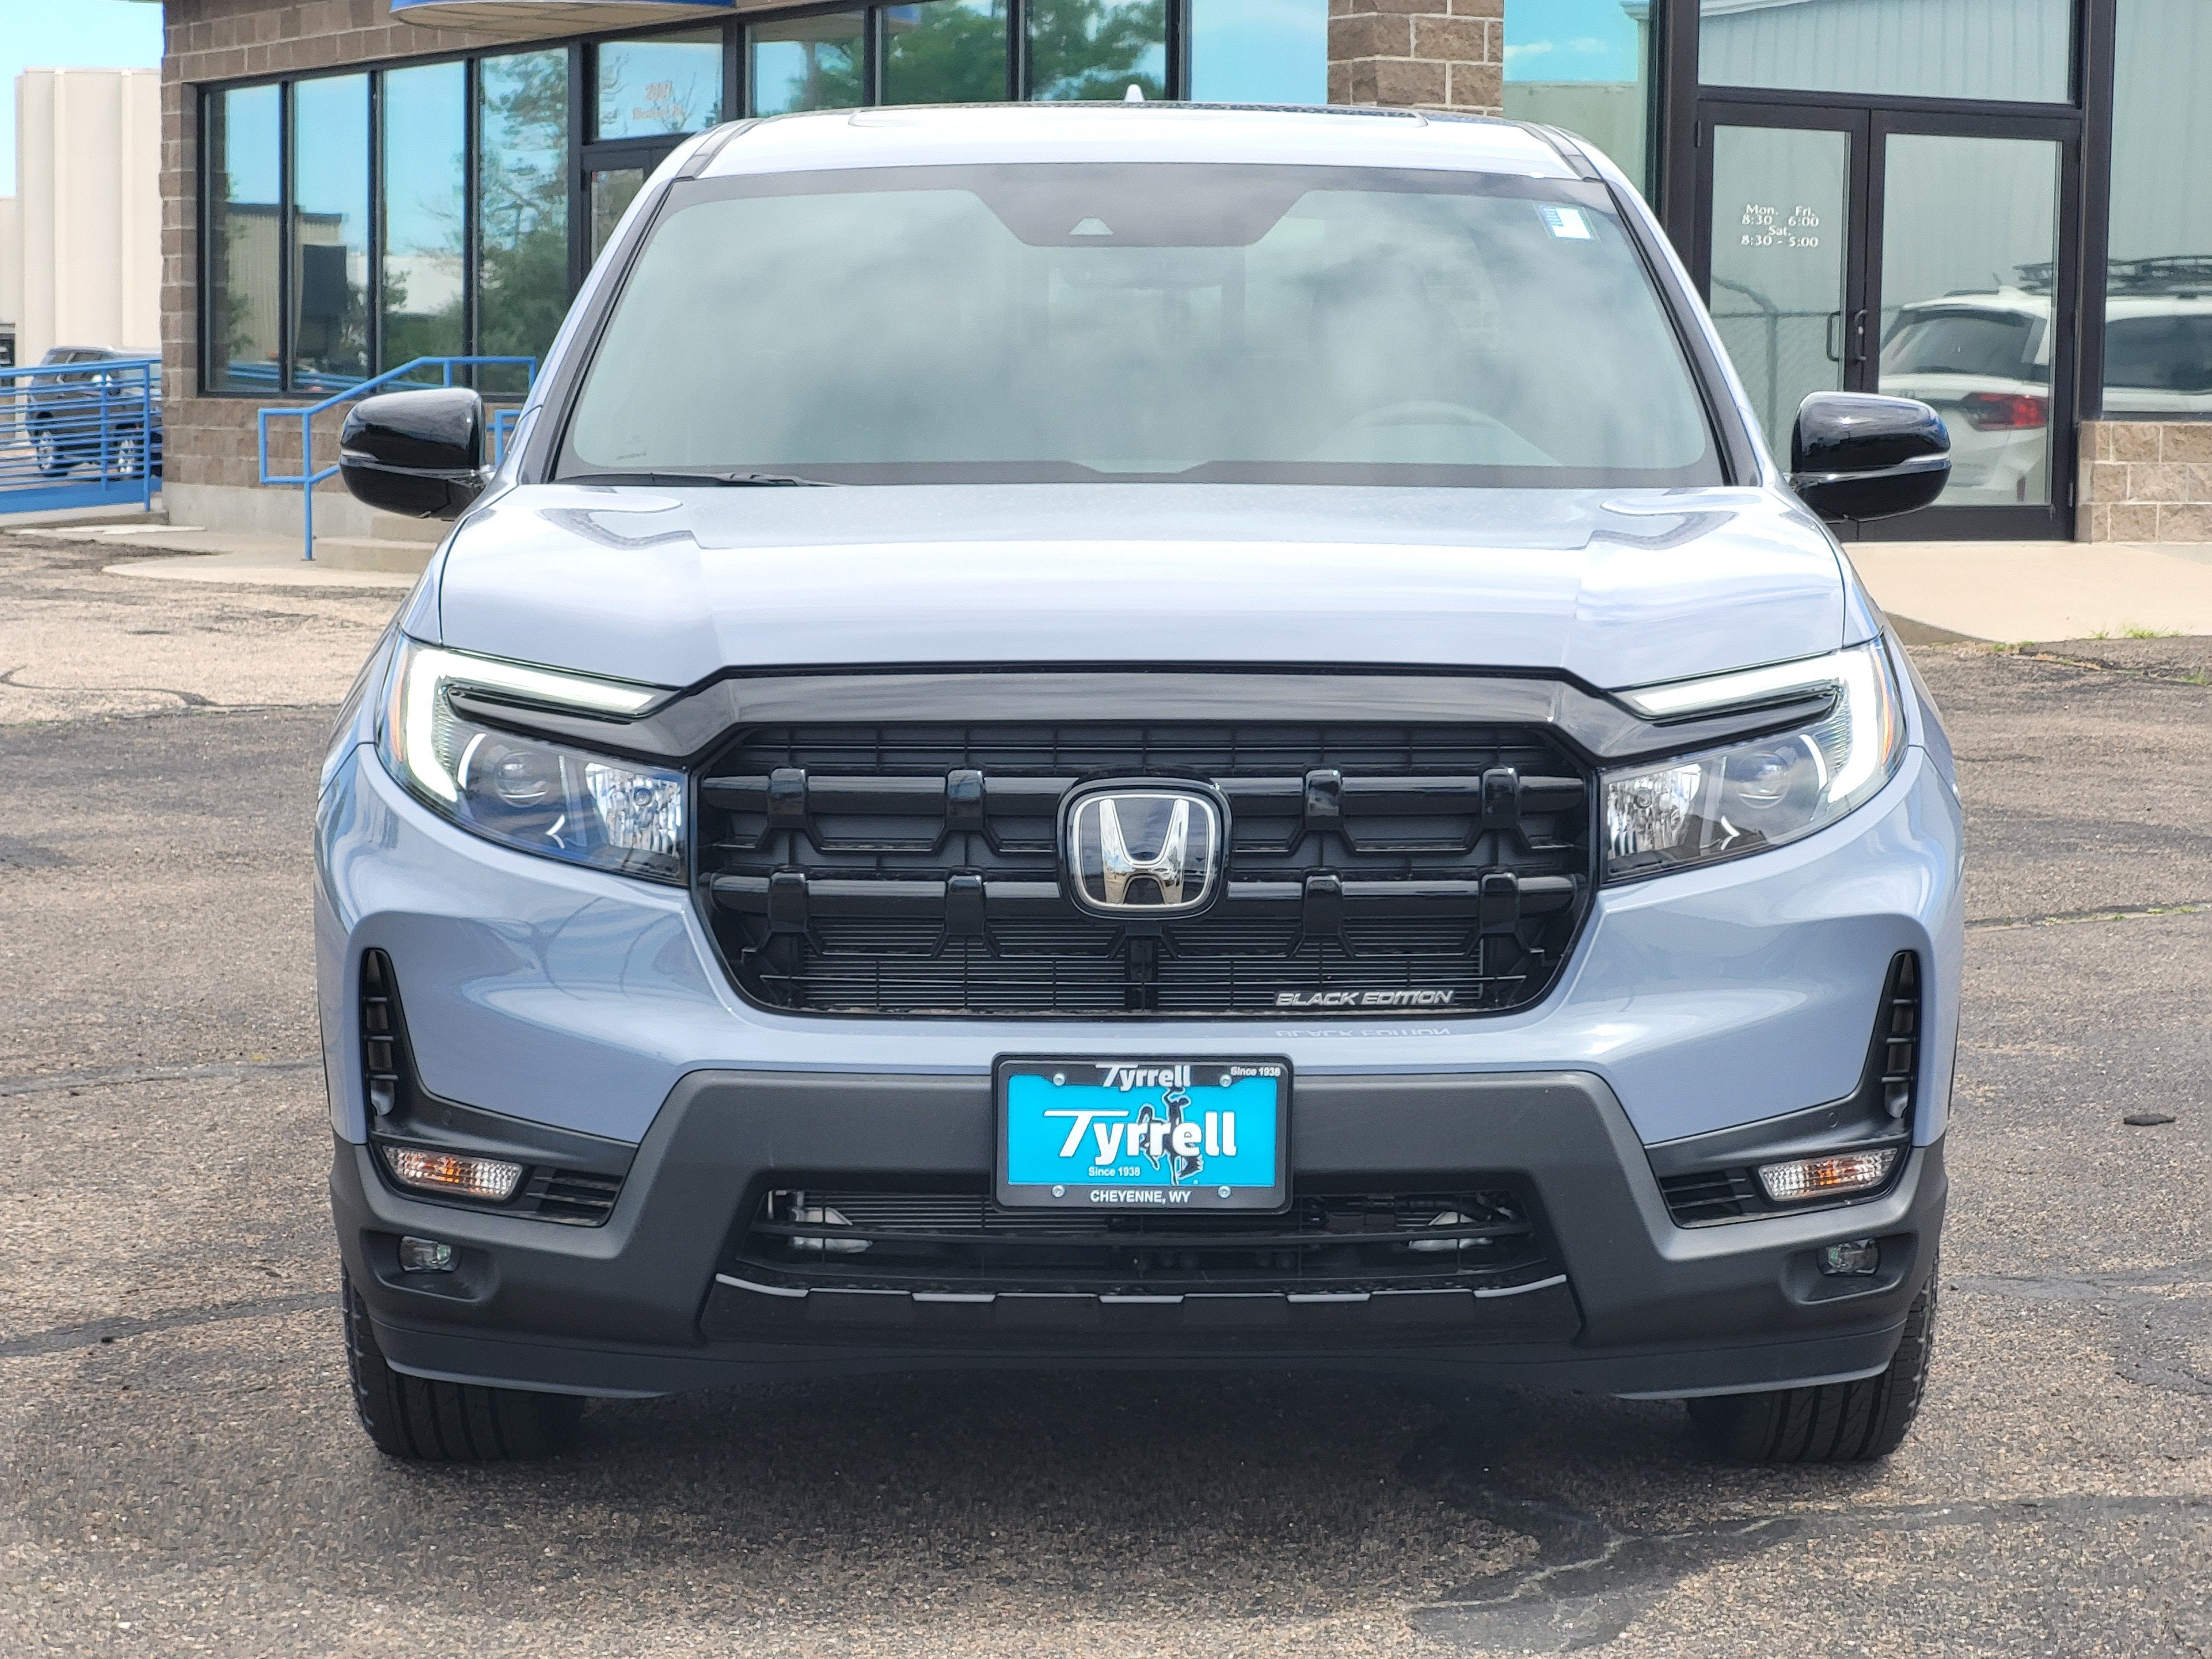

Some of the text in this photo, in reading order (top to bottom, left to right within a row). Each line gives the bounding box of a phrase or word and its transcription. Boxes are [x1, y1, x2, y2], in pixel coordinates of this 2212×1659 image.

[1746, 204, 1779, 215] Mon.
[1742, 214, 1819, 227] 8:30 6:00
[1768, 225, 1792, 236] Sat.
[1741, 234, 1772, 246] 8:30
[1788, 237, 1819, 247] 5:00
[1275, 990, 1453, 1006] BLACK EDITION
[1095, 1064, 1191, 1092] Tyrrell
[1230, 1067, 1281, 1077] Since 1938
[1044, 1109, 1237, 1165] Tyrrell
[1088, 1166, 1141, 1177] Since 1938
[1090, 1190, 1191, 1204] CHEYENNE, WY
